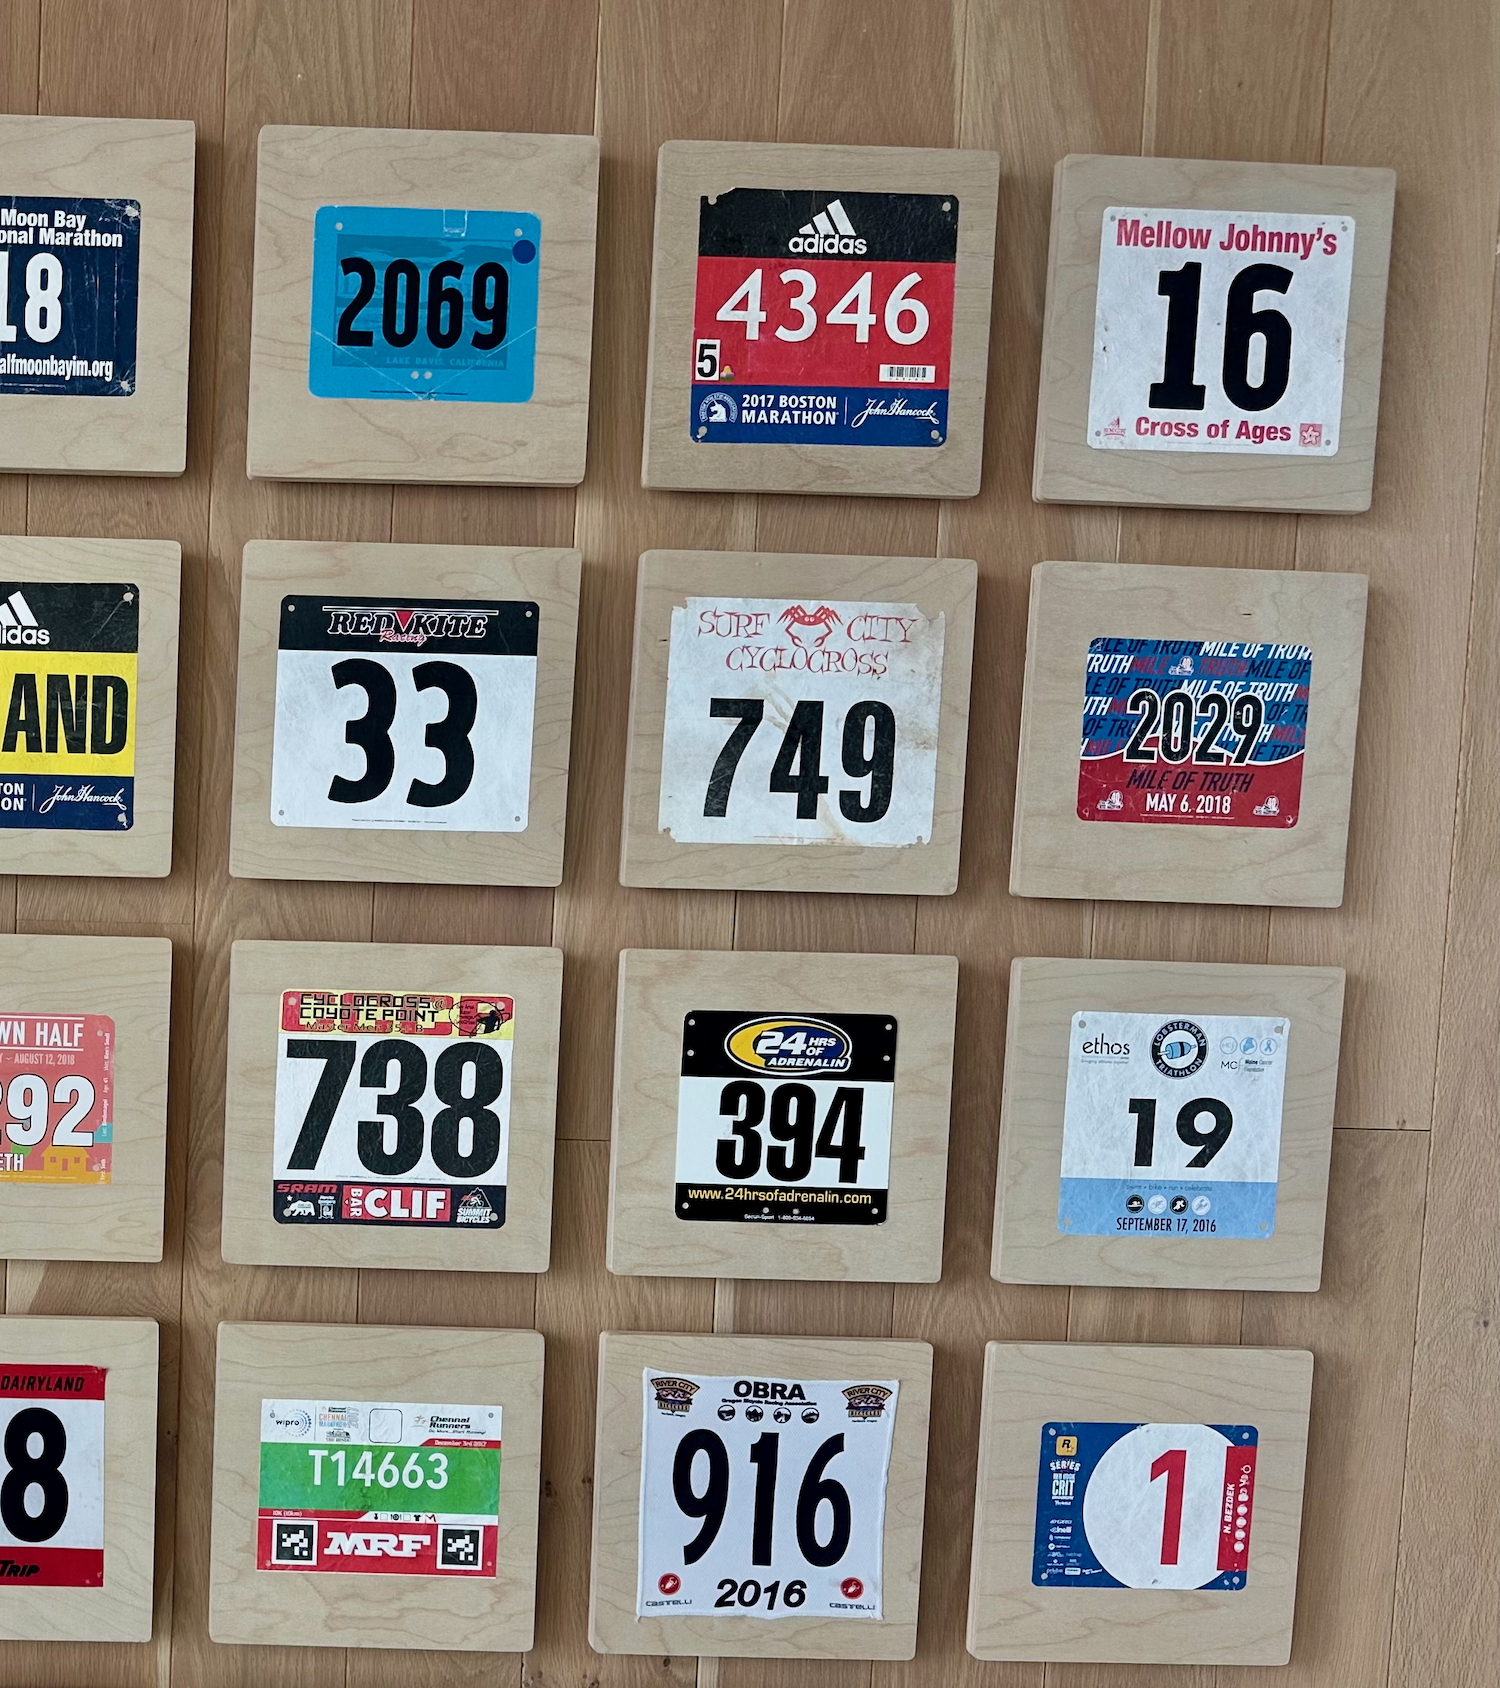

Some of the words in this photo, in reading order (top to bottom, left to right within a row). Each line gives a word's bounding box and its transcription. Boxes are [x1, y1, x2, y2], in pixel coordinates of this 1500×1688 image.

[1, 208, 48, 227] Moon
[54, 210, 87, 232] Bay
[39, 227, 123, 247] Marathon
[789, 234, 867, 255] adidas
[1116, 218, 1212, 250] Mellow
[1219, 223, 1338, 260] Johnny's
[337, 256, 509, 351] 2069
[716, 268, 930, 345] 4346
[1149, 261, 1294, 412] 16
[697, 343, 717, 378] 5
[742, 394, 774, 408] 2017
[779, 395, 836, 409] BOSTON
[742, 411, 836, 425] MARATHON
[1135, 417, 1199, 438] Cross
[1207, 420, 1230, 439] of
[1235, 420, 1292, 444] Ages
[698, 606, 771, 638] SURF
[846, 612, 918, 643] CITY
[725, 644, 890, 678] CYCLOCROSS
[328, 658, 477, 808] 33
[1123, 688, 1265, 766] 2029
[703, 697, 896, 823] 749
[1146, 793, 1177, 812] MAY
[1196, 795, 1231, 814] 2018
[300, 993, 431, 1009] CYCLOCROSS
[432, 998, 446, 1010] @
[300, 1007, 377, 1021] COYOTE
[382, 1010, 440, 1023] POINT
[36, 1022, 84, 1047] HALF
[755, 1031, 807, 1055] 24
[808, 1037, 837, 1047] HRS
[1083, 1033, 1130, 1056] ethos
[1153, 1022, 1206, 1047] LOBSTERMAN
[14, 1053, 43, 1064] AUGUST
[45, 1054, 55, 1066] 12,
[57, 1054, 75, 1065] 2018
[767, 1057, 846, 1068] ADRENALIN
[1155, 1058, 1203, 1077] TRIATHLON
[286, 1038, 503, 1178] 738
[716, 1080, 866, 1184] 394
[1128, 1097, 1233, 1168] 19
[276, 1183, 338, 1194] SRAM
[688, 1187, 872, 1204] www.24hrsofadrenalin.com
[350, 1187, 363, 1218] BAR
[364, 1188, 446, 1219] CLIF
[1117, 1217, 1172, 1231] SEPTEMBER
[1177, 1218, 1188, 1234] 17,
[1193, 1219, 1216, 1232] 2016
[0, 1375, 84, 1392] DAIRYLAND
[733, 1380, 806, 1400] OBRA
[308, 1449, 449, 1490] T14663
[1049, 1460, 1081, 1472] SERIES
[672, 1428, 851, 1568] 916
[1052, 1480, 1075, 1496] CRIT
[1150, 1449, 1187, 1565] 1
[1224, 1483, 1236, 1522] BEZDEK
[1223, 1523, 1232, 1534] N.
[323, 1532, 431, 1558] MRF
[714, 1578, 807, 1611] 2016
